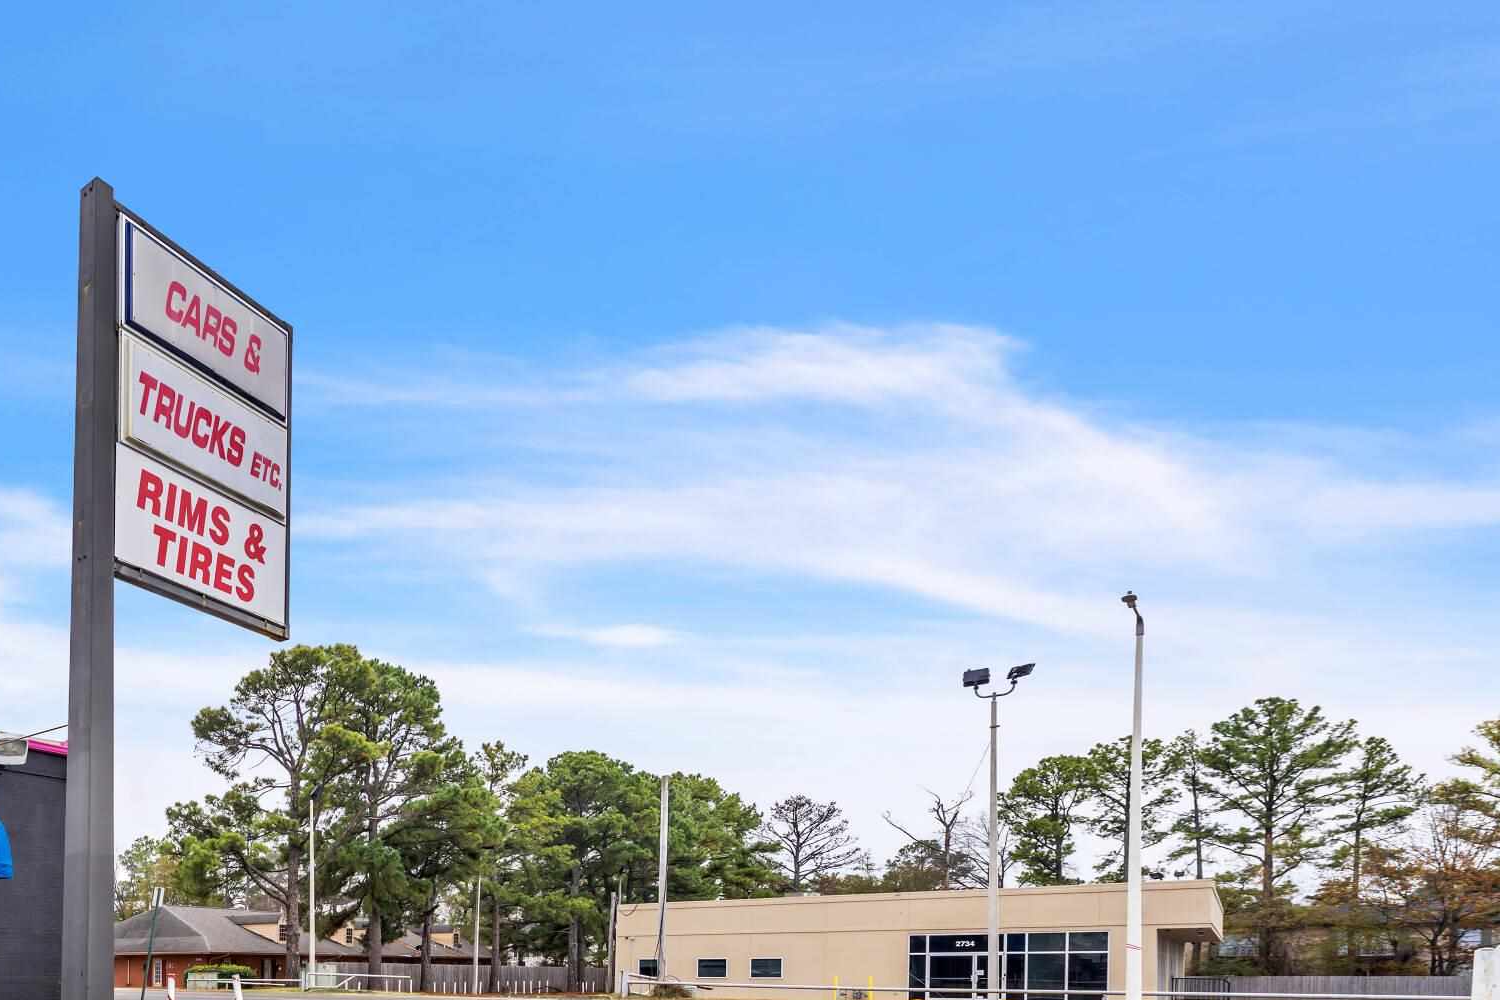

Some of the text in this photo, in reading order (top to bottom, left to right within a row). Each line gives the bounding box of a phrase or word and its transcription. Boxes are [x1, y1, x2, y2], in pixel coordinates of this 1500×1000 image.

[165, 280, 261, 375] CARS &
[139, 371, 282, 491] TRUCKS ETC.
[136, 469, 267, 565] RIMS &
[153, 525, 256, 602] TIRES
